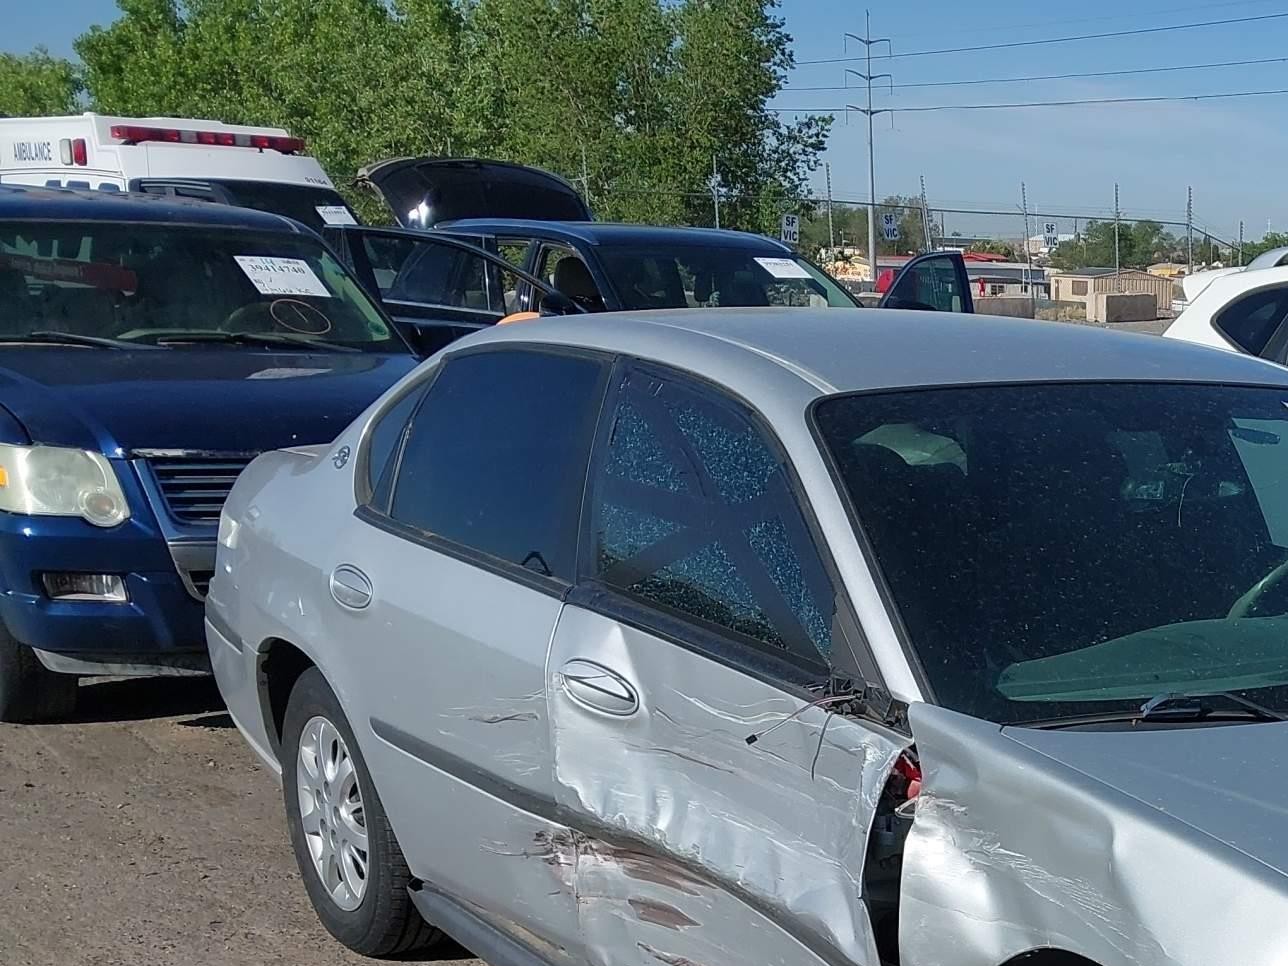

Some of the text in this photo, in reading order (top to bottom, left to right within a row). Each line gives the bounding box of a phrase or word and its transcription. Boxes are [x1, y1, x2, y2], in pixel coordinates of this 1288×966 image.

[13, 142, 52, 161] AMBULANCE
[884, 214, 893, 225] SF
[884, 227, 898, 238] VIC
[1045, 223, 1055, 234] SF
[1045, 236, 1058, 246] VIC
